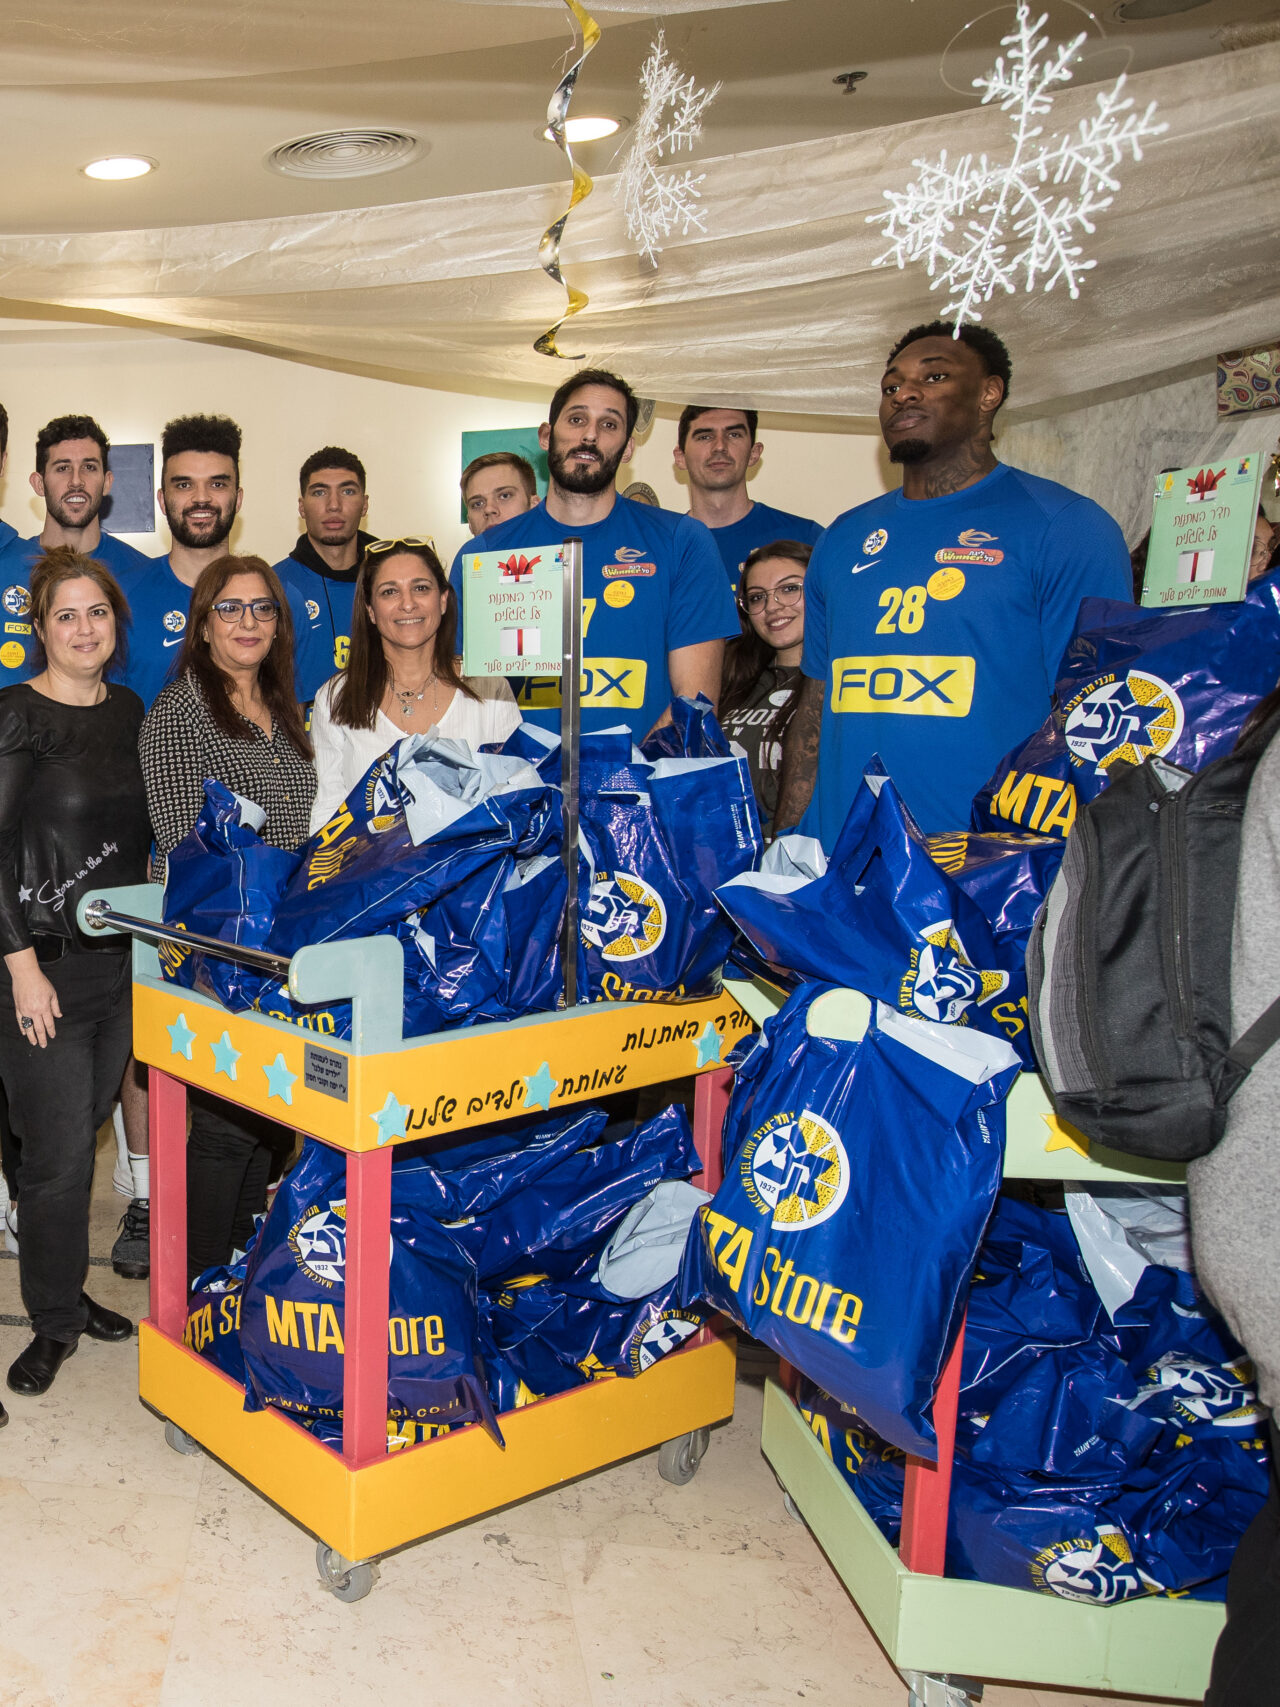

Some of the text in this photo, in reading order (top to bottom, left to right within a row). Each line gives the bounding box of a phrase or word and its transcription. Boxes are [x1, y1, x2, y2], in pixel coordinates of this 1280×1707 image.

[1173, 506, 1230, 527] חדר המתנות
[1176, 525, 1218, 547] על גלגלים
[943, 551, 984, 561] Winner
[488, 589, 552, 605] חדר המתנות
[875, 585, 927, 634] 28
[7, 624, 29, 633] FOX
[494, 605, 541, 623] על גלגלים
[534, 661, 562, 671] עמותת
[839, 667, 957, 704] FOX
[1071, 740, 1087, 748] 1932
[365, 781, 376, 811] MACCABI
[376, 787, 386, 799] 1932
[990, 770, 1077, 838] MTA
[75, 869, 88, 880] in
[85, 856, 102, 869] the
[101, 842, 118, 857] sky
[621, 1009, 753, 1052] חדר המתנות
[405, 1064, 628, 1132] עמותת ילדים שלנו
[753, 1112, 790, 1140] תל-אביב
[740, 1140, 771, 1216] MACCABI TEL AVIV
[759, 1180, 776, 1193] 1932
[700, 1206, 754, 1293] TA
[295, 1255, 334, 1289] MACCABI TEL
[753, 1246, 864, 1344] Store
[265, 1294, 345, 1354] MTA
[389, 1315, 446, 1357] ore
[631, 1334, 642, 1346] TEL
[1073, 1538, 1093, 1551] כבי
